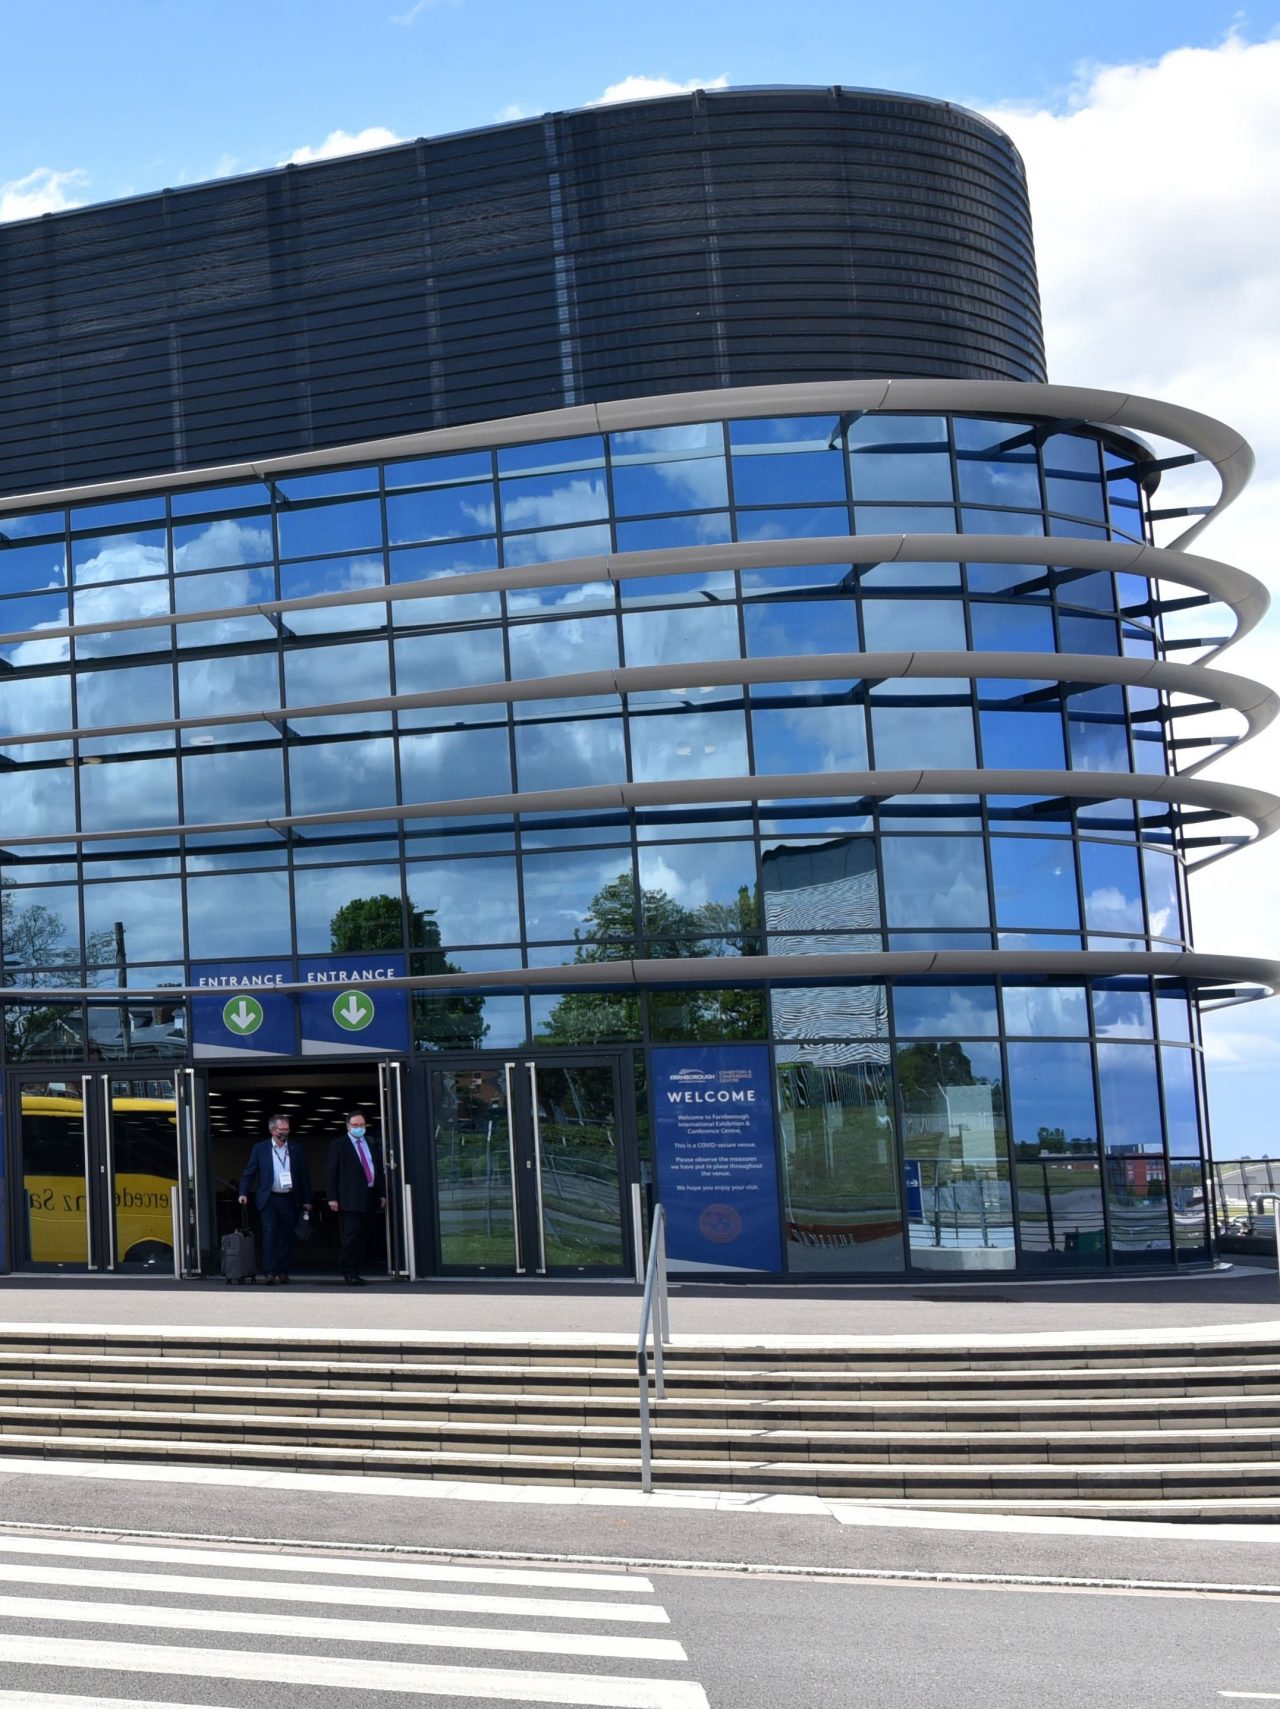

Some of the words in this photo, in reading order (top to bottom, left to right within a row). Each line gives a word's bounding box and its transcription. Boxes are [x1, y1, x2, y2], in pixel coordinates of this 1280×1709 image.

[199, 974, 283, 988] ENTRANCE
[308, 968, 395, 984] ENTRANCE
[667, 1090, 756, 1103] WELCOME
